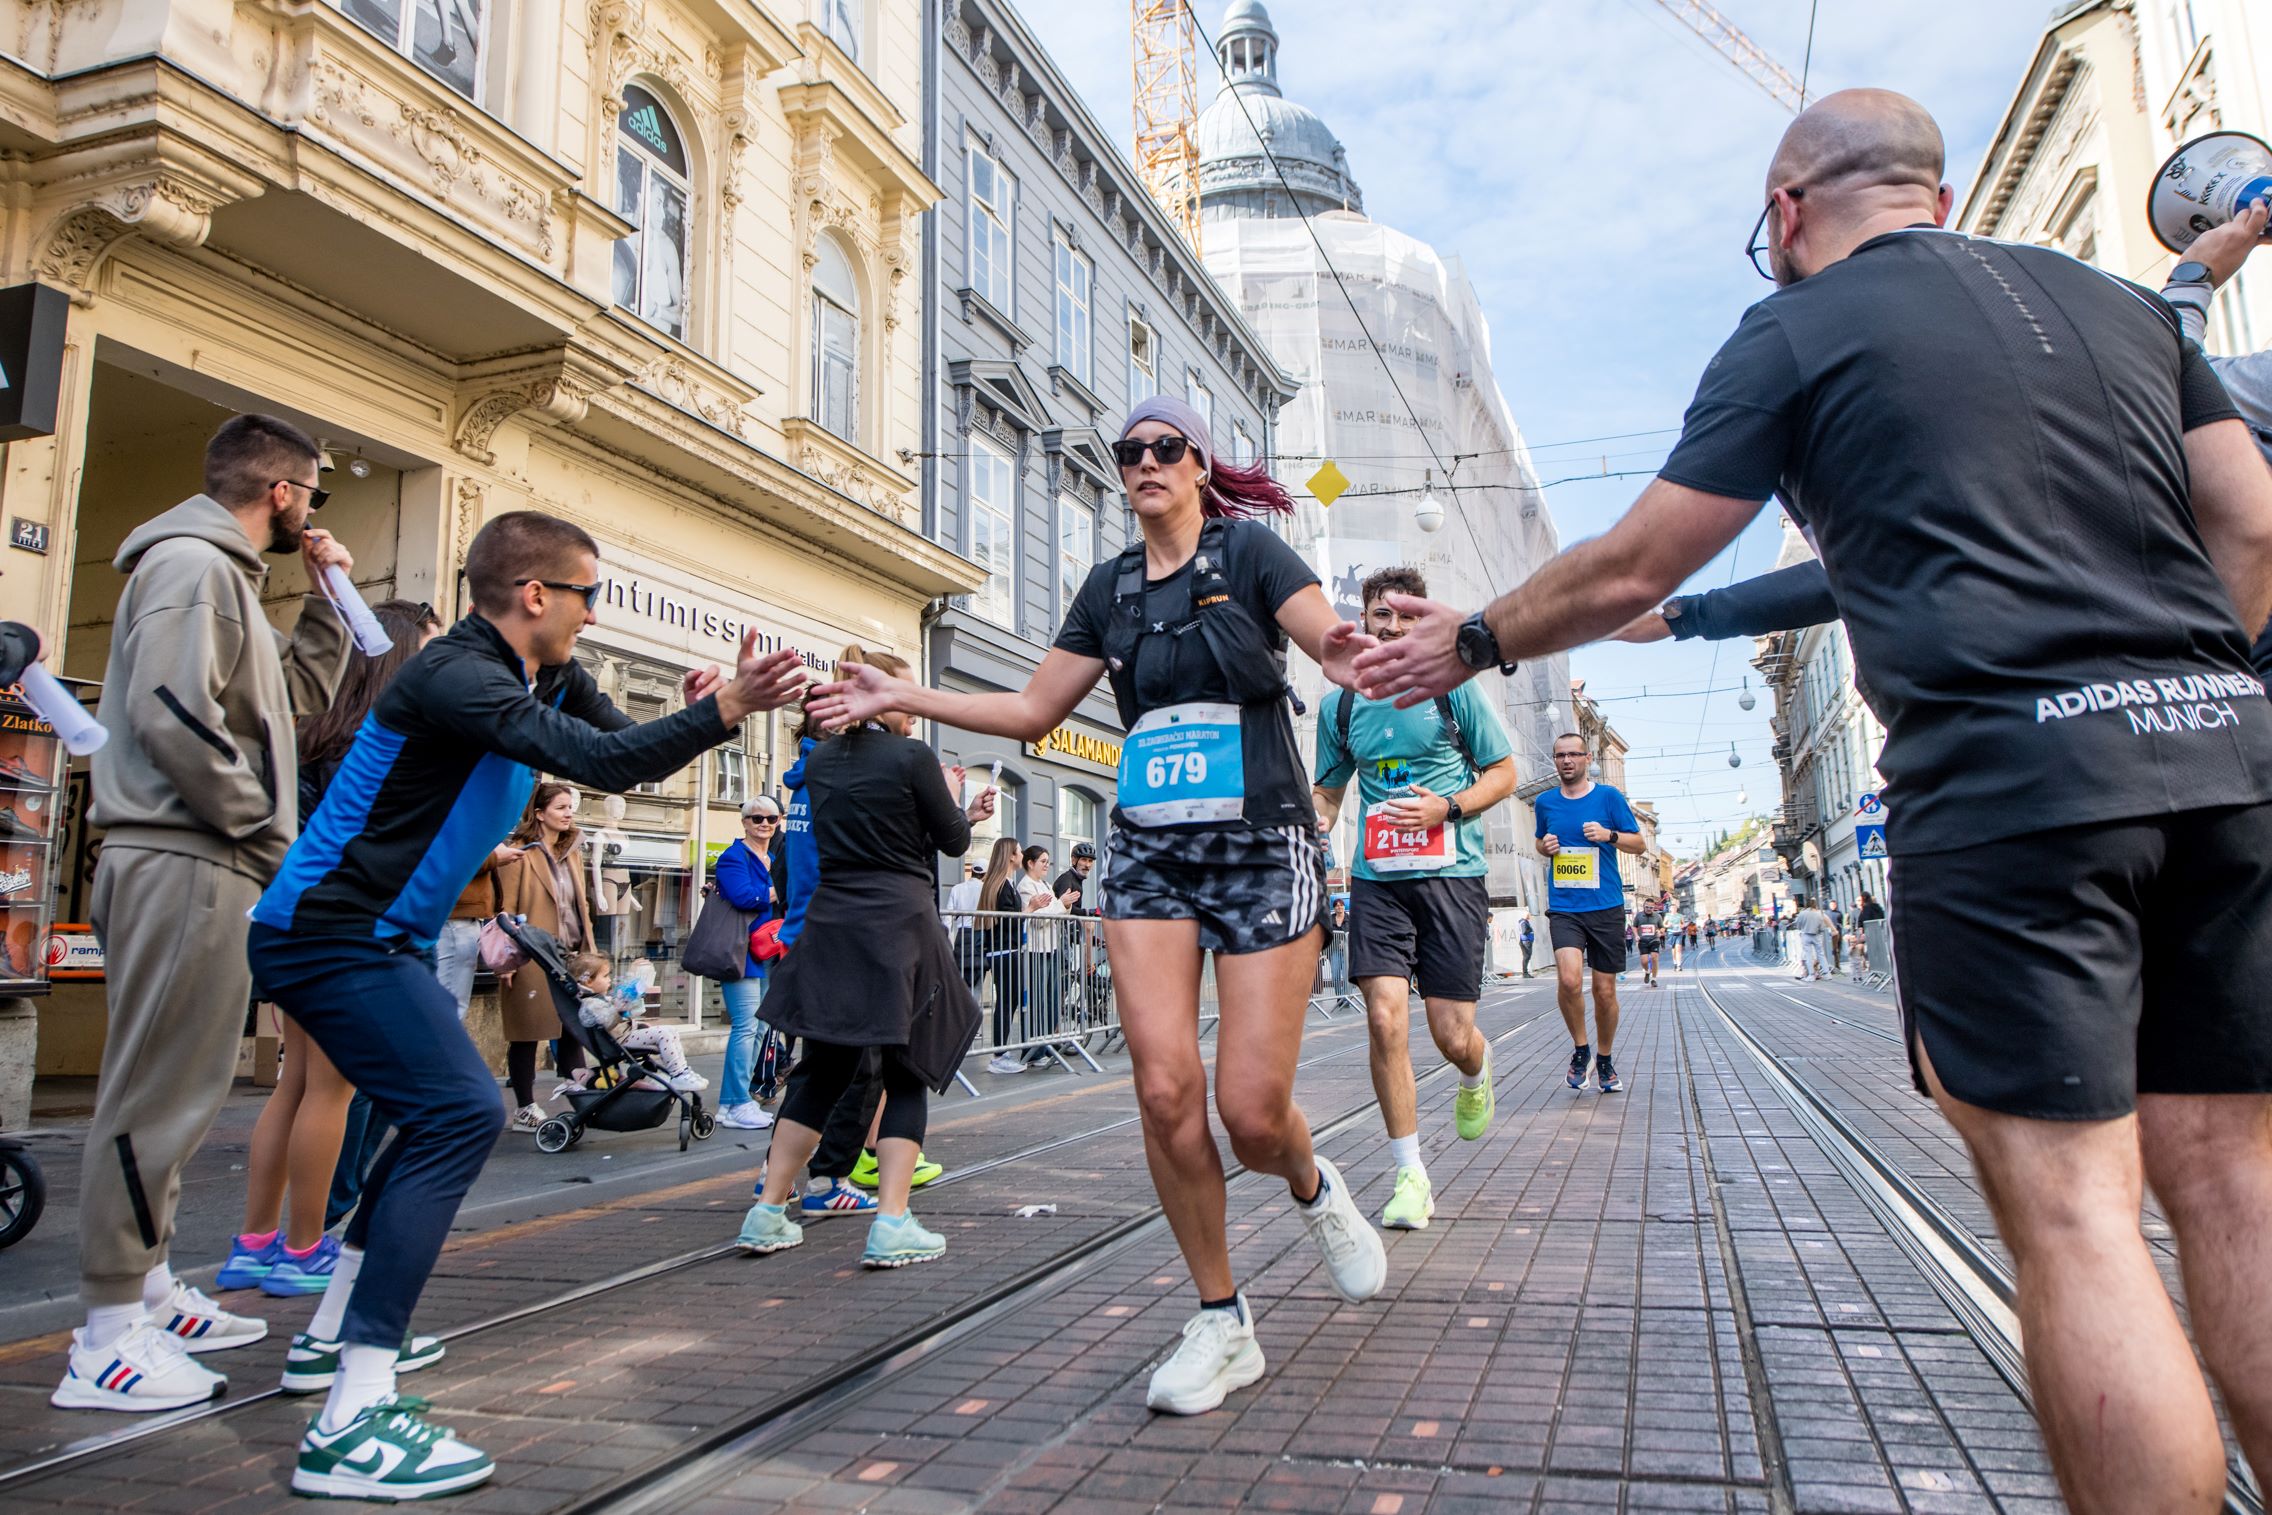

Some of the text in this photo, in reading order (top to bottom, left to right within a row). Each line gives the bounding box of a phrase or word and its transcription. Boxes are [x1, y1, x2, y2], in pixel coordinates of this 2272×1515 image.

[628, 116, 667, 153] adidas
[1335, 339, 1367, 351] MAR
[1388, 343, 1412, 361] MAR
[1343, 411, 1376, 423] MAR
[1392, 413, 1417, 429] MAR
[20, 522, 42, 539] 21
[1198, 594, 1230, 606] KIPRUN
[604, 577, 784, 656] ntimissimi
[2036, 672, 2265, 723] ADIDAS RUNNERS
[1, 714, 53, 733] Zlatko
[2126, 701, 2239, 735] MUNICH
[1185, 730, 1220, 740] MARATON
[1146, 751, 1207, 789] 679
[1377, 829, 1429, 850] 2144
[1556, 864, 1587, 875] 6006C
